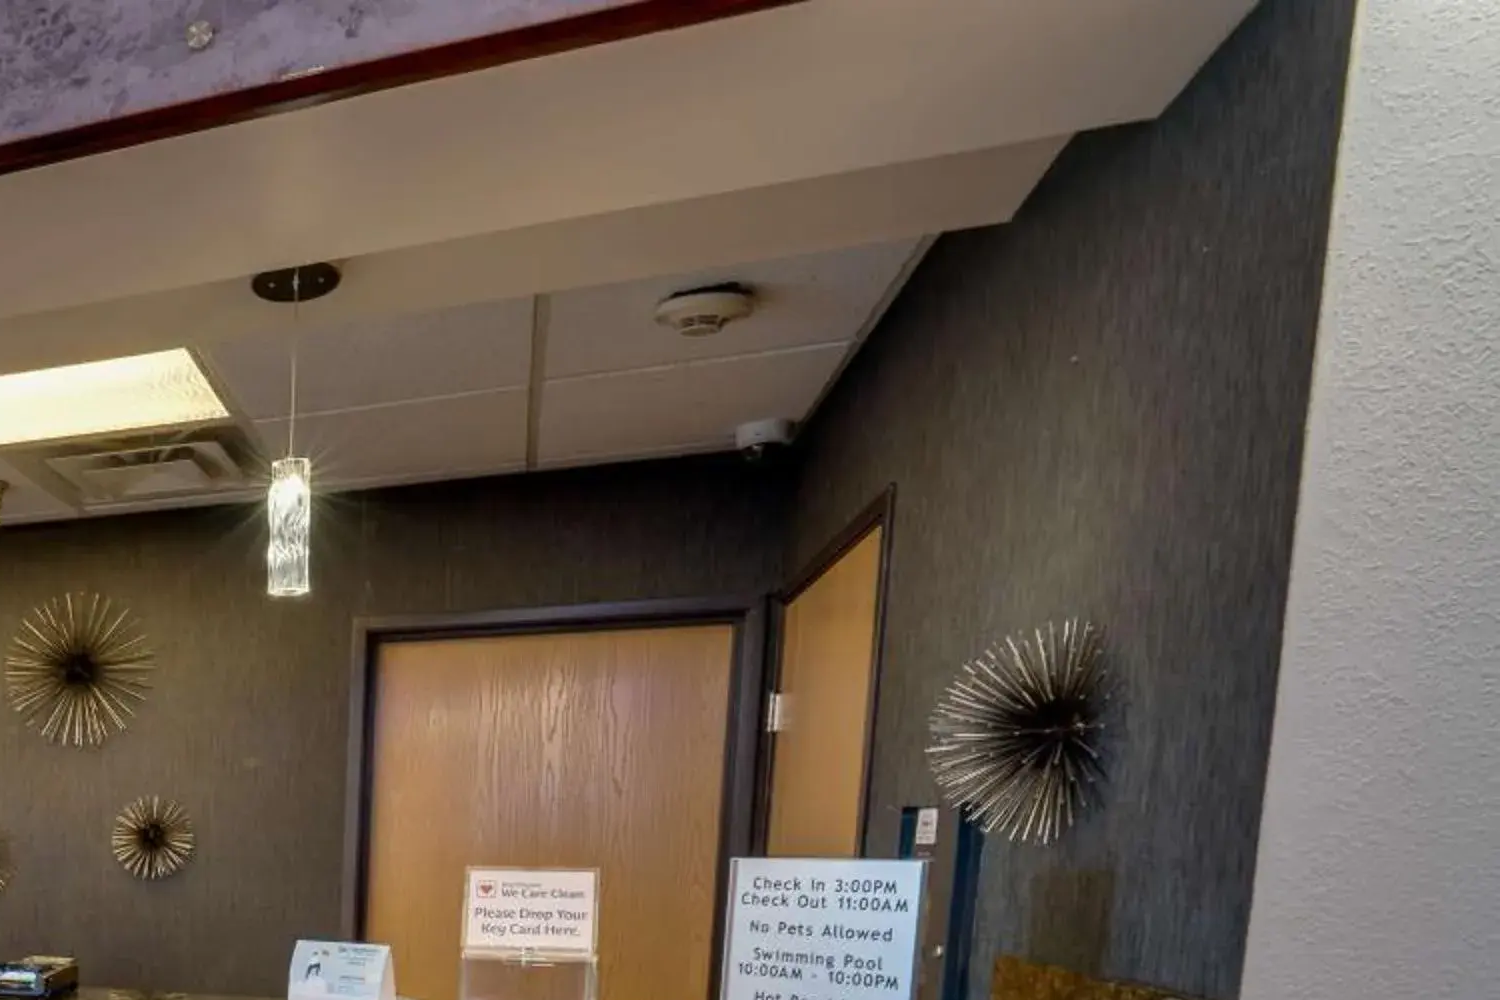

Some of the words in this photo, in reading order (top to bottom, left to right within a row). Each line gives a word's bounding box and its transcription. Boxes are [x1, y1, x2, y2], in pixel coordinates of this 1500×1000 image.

[501, 887, 519, 898] We
[521, 888, 548, 899] Care
[753, 877, 801, 892] Check
[811, 879, 825, 892] In
[835, 879, 897, 894] 3:00PM
[741, 892, 789, 907] Check
[797, 894, 827, 909] Out
[838, 897, 909, 912] 11:00AM
[475, 907, 516, 919] Please
[519, 908, 553, 921] Drop
[557, 909, 588, 920] Your
[481, 923, 506, 937] Key
[509, 923, 540, 936] Card
[749, 920, 769, 933] No
[778, 922, 813, 936] Pets
[821, 924, 893, 942] Allowed
[753, 948, 834, 968] Swimming
[843, 953, 883, 970] Pool
[739, 964, 803, 980] 10:00AM
[828, 971, 899, 990] 10:00PM
